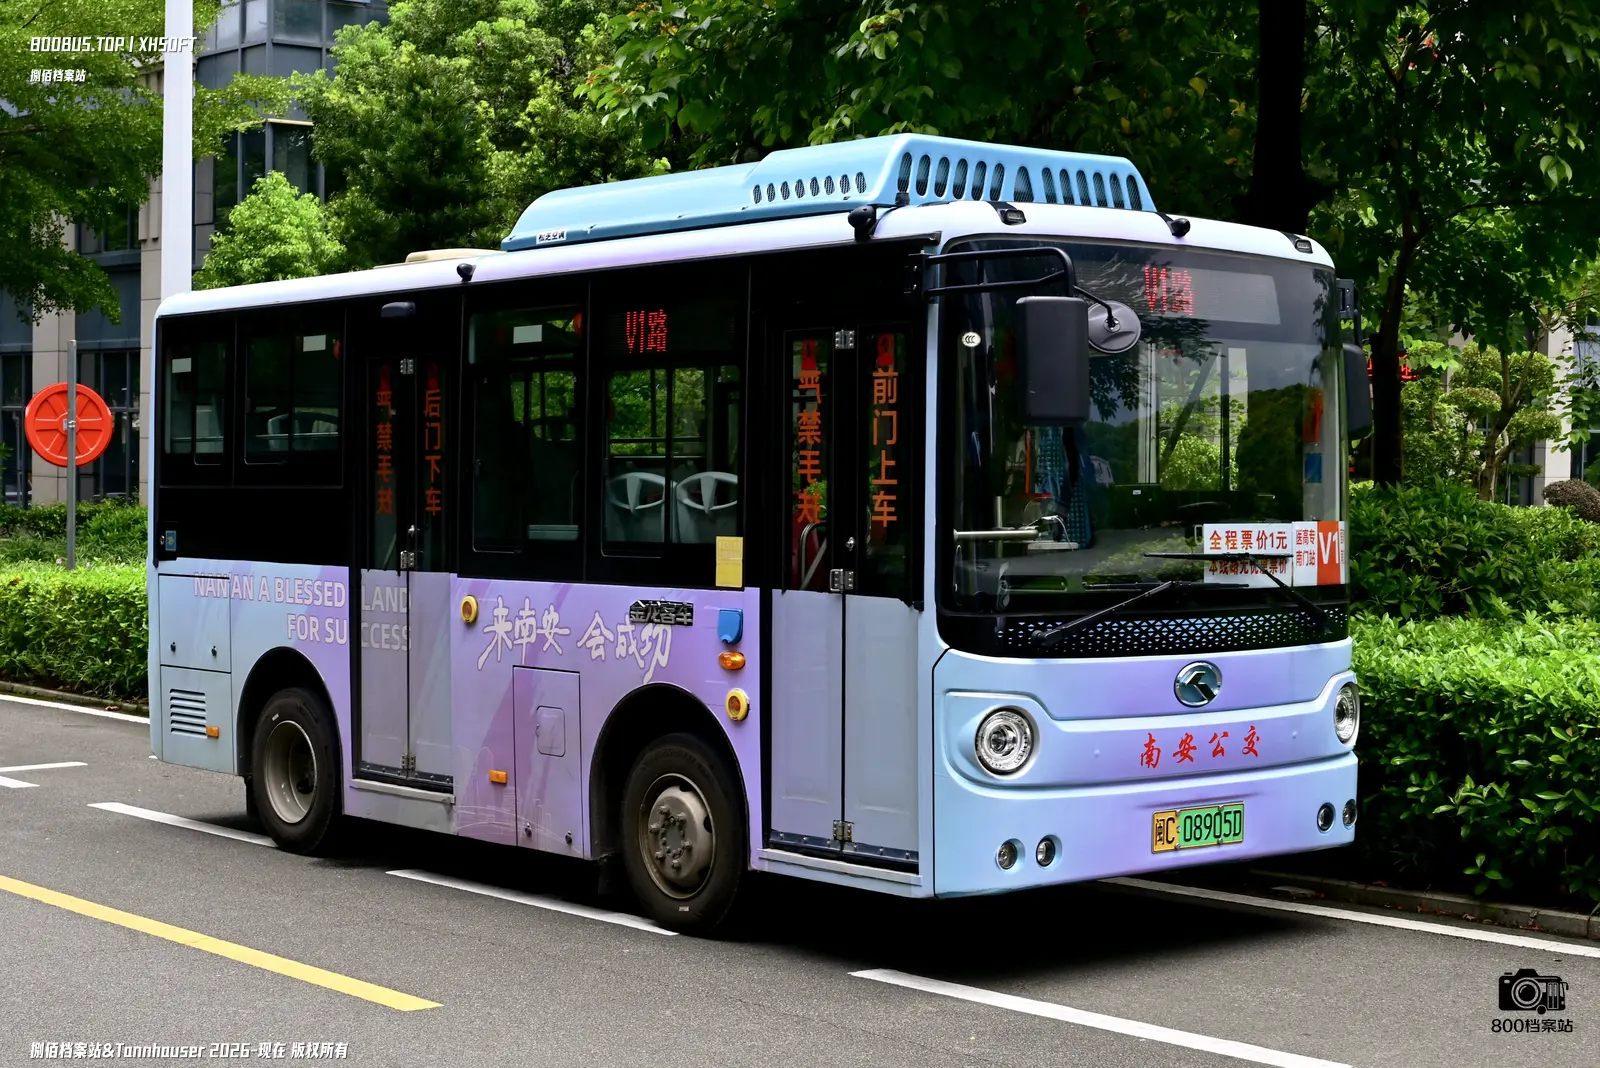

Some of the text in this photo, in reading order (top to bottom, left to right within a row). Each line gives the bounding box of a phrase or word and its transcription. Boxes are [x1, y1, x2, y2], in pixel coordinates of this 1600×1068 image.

[1144, 265, 1194, 316] V1路
[626, 308, 668, 353] V1路
[425, 388, 442, 517] 后门下车
[872, 367, 898, 528] 前门上车
[1209, 530, 1288, 550] 全程票价1元
[1296, 551, 1316, 567] 南门站
[1318, 530, 1340, 565] V1
[193, 573, 412, 613] NAN'AN A BLESSED LAND
[287, 613, 320, 642] FOR
[1140, 725, 1260, 768] 南安公交
